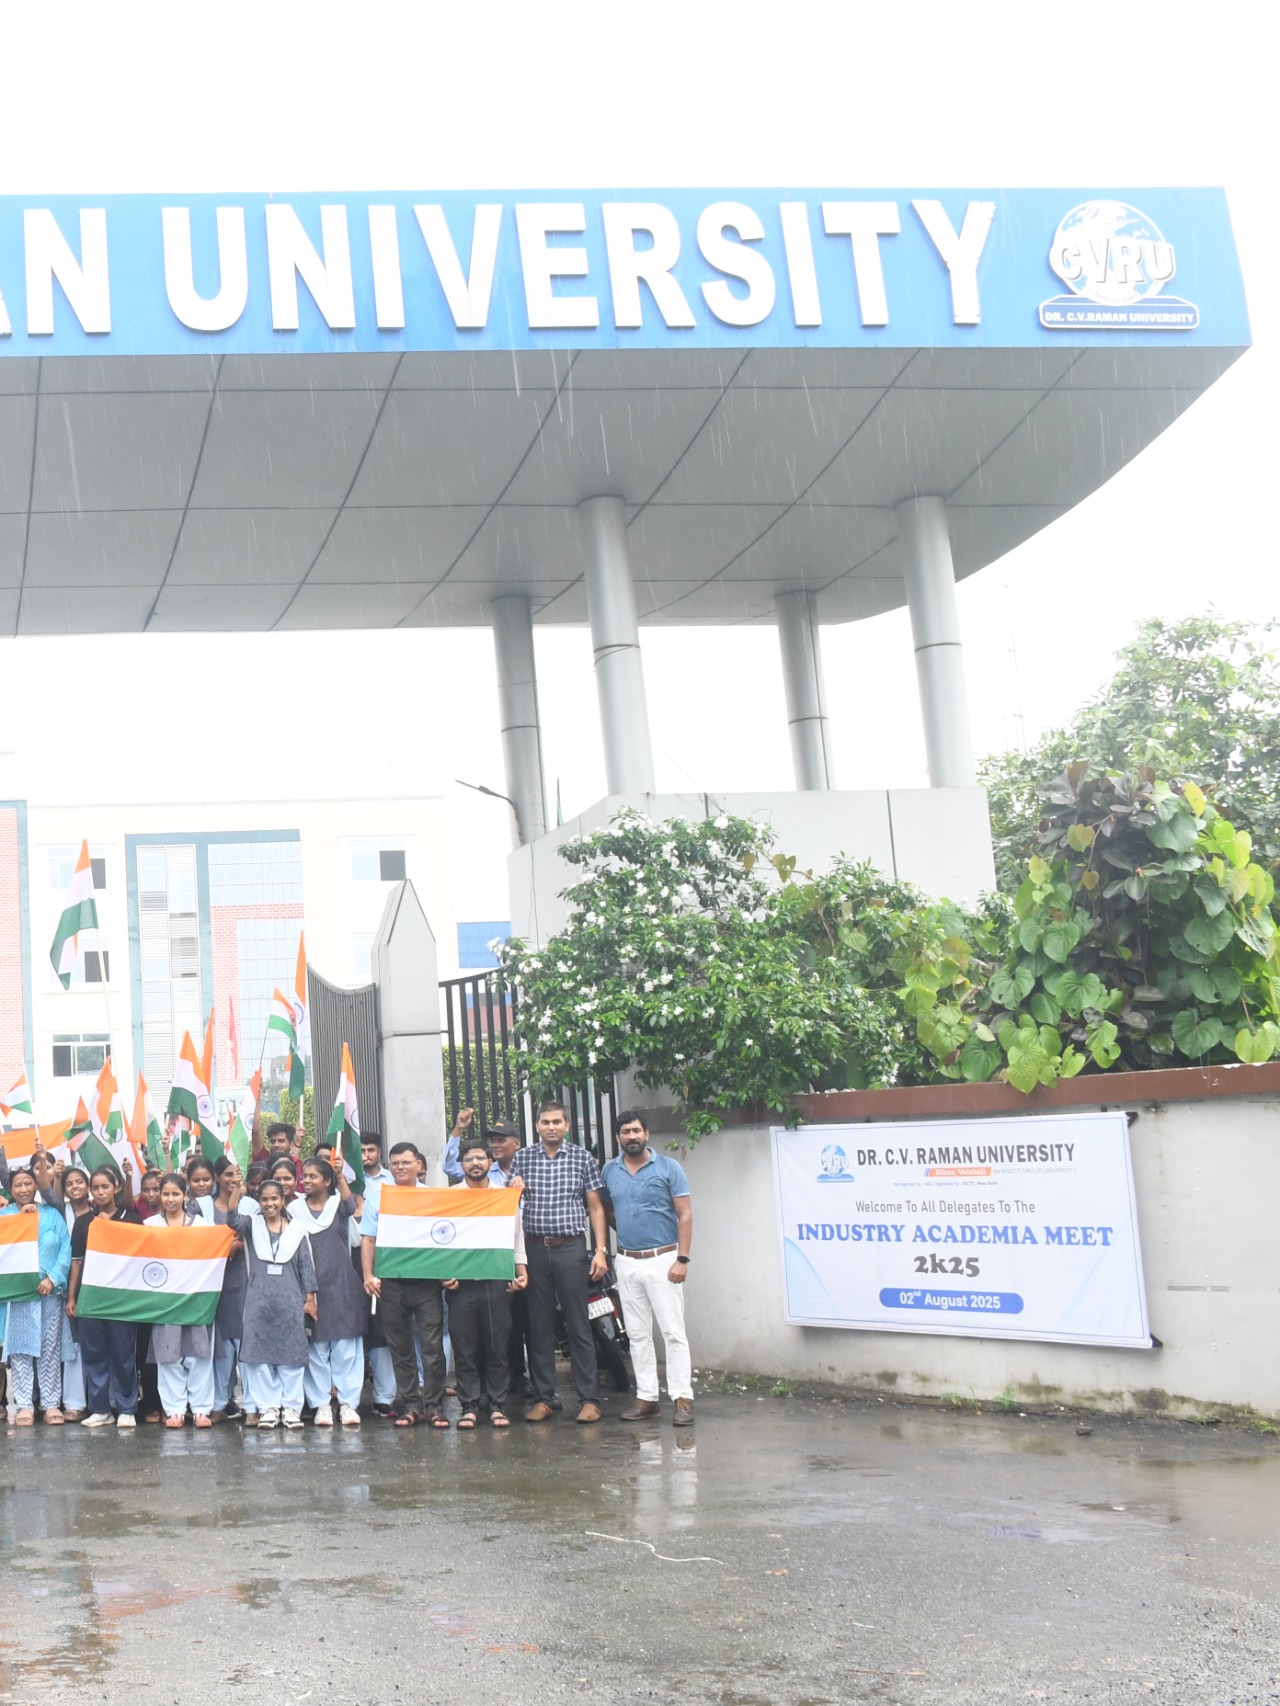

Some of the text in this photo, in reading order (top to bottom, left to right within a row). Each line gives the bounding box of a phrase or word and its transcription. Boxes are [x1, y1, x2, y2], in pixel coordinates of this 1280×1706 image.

[161, 200, 997, 332] UNIVERSITY
[1054, 238, 1175, 284] CVRU
[1044, 312, 1064, 322] DR.
[1129, 312, 1195, 323] UNIVERSITY
[857, 1143, 1075, 1166] DR. C.V. RAMAN UNIVERSITY
[855, 1200, 1035, 1215] Welcome To All Delegates To The
[797, 1223, 1114, 1247] INDUSTRY ACADEMIA MEET
[914, 1253, 980, 1278] 2k25
[899, 1290, 1001, 1310] 02nd August 2025
